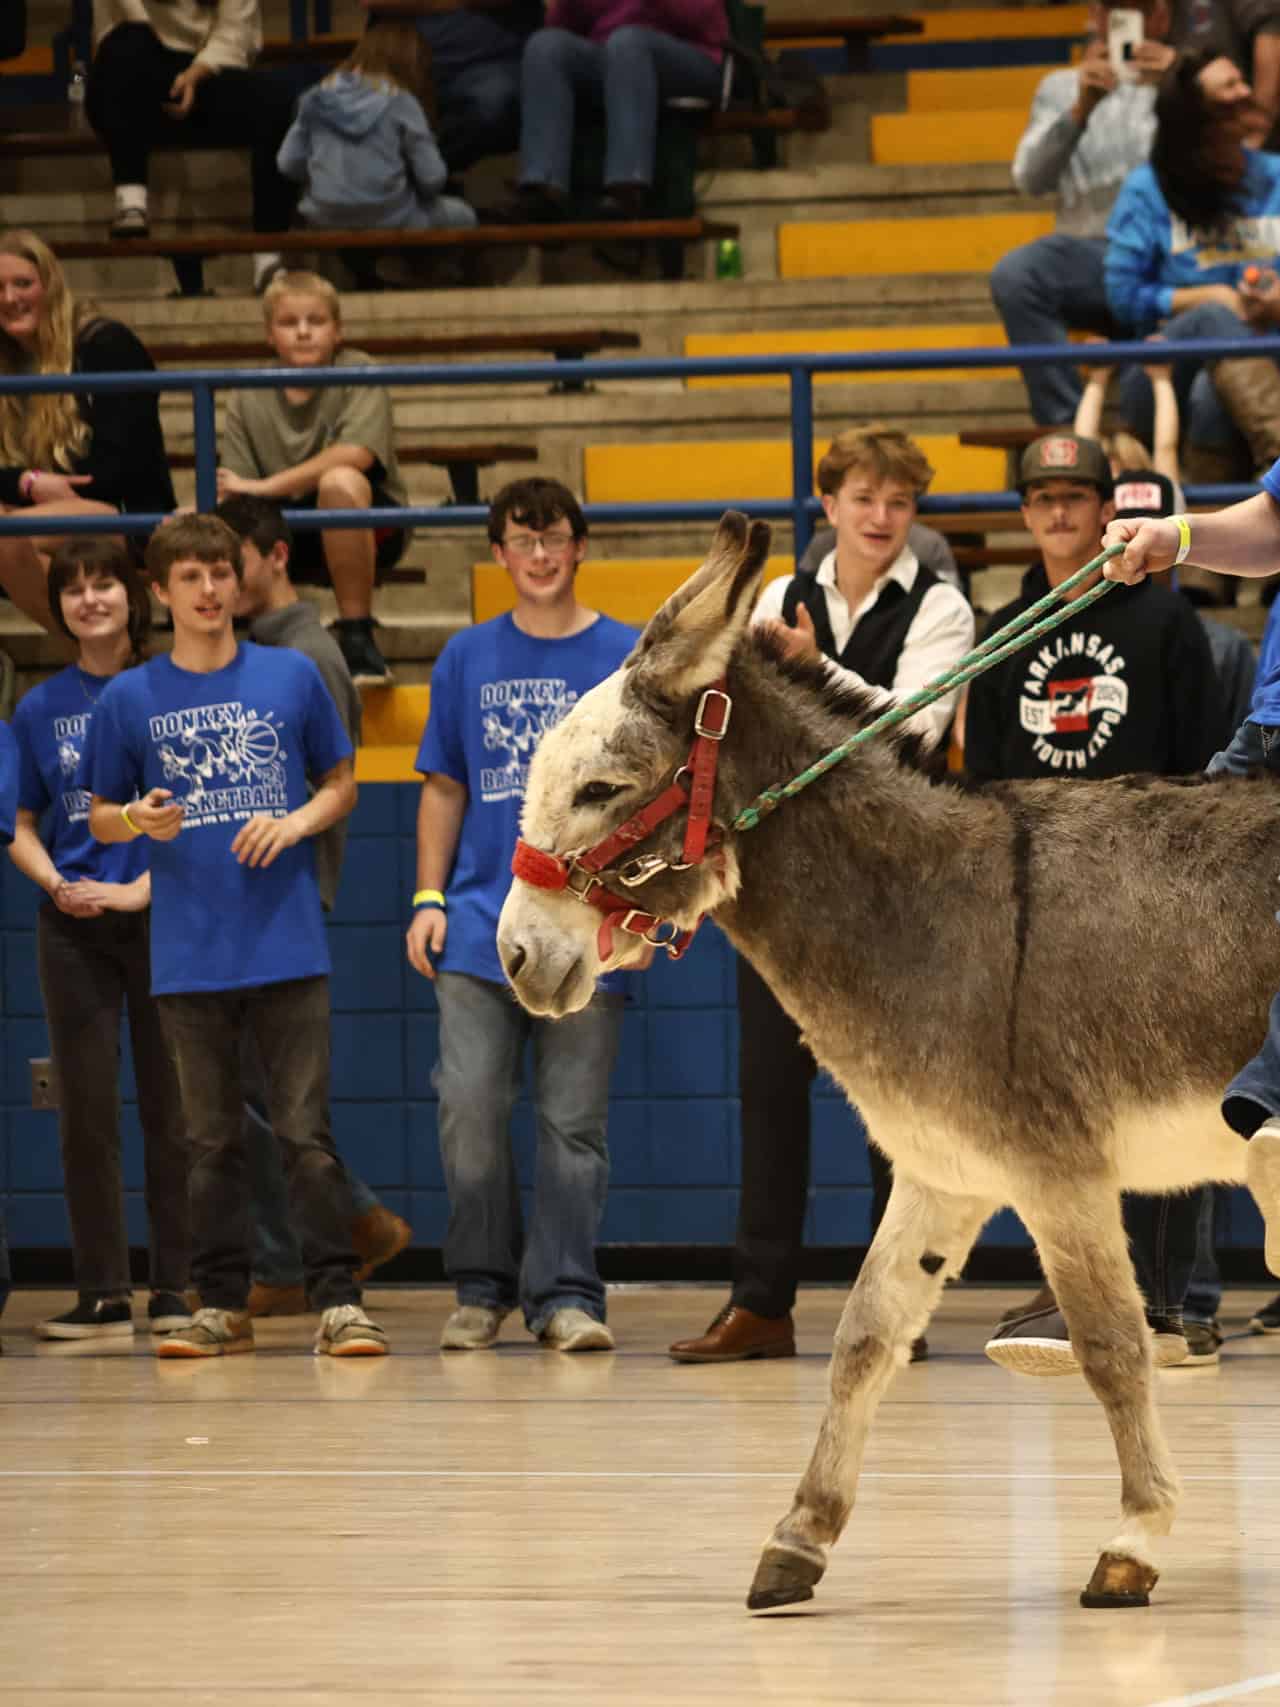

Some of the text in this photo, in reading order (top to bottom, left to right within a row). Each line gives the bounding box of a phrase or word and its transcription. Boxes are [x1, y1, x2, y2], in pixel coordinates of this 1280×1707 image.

[1023, 632, 1125, 696] ARKANSAS
[149, 701, 244, 742] DONKEY
[1032, 735, 1087, 770] YOUTH
[164, 783, 288, 818] SKETBALL
